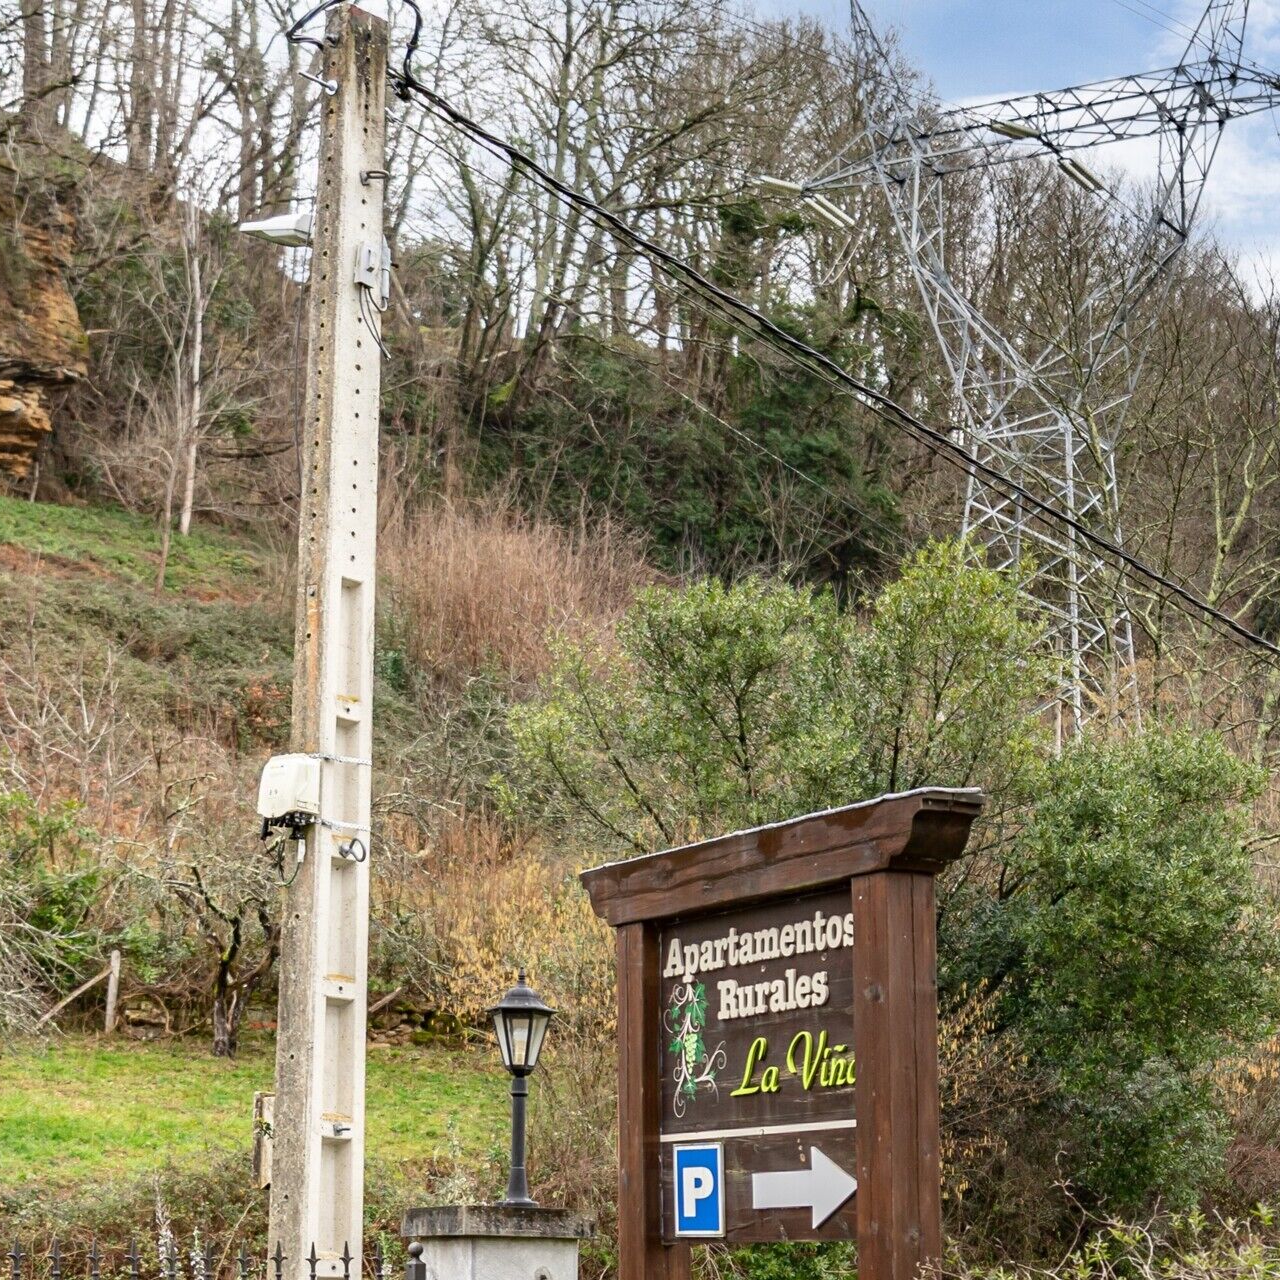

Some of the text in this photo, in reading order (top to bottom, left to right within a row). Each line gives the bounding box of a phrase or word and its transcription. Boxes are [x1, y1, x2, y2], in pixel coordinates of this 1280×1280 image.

[663, 911, 854, 983] Apartamentos
[717, 969, 829, 1020] Rurales
[730, 1037, 780, 1097] La
[682, 1166, 714, 1217] P
